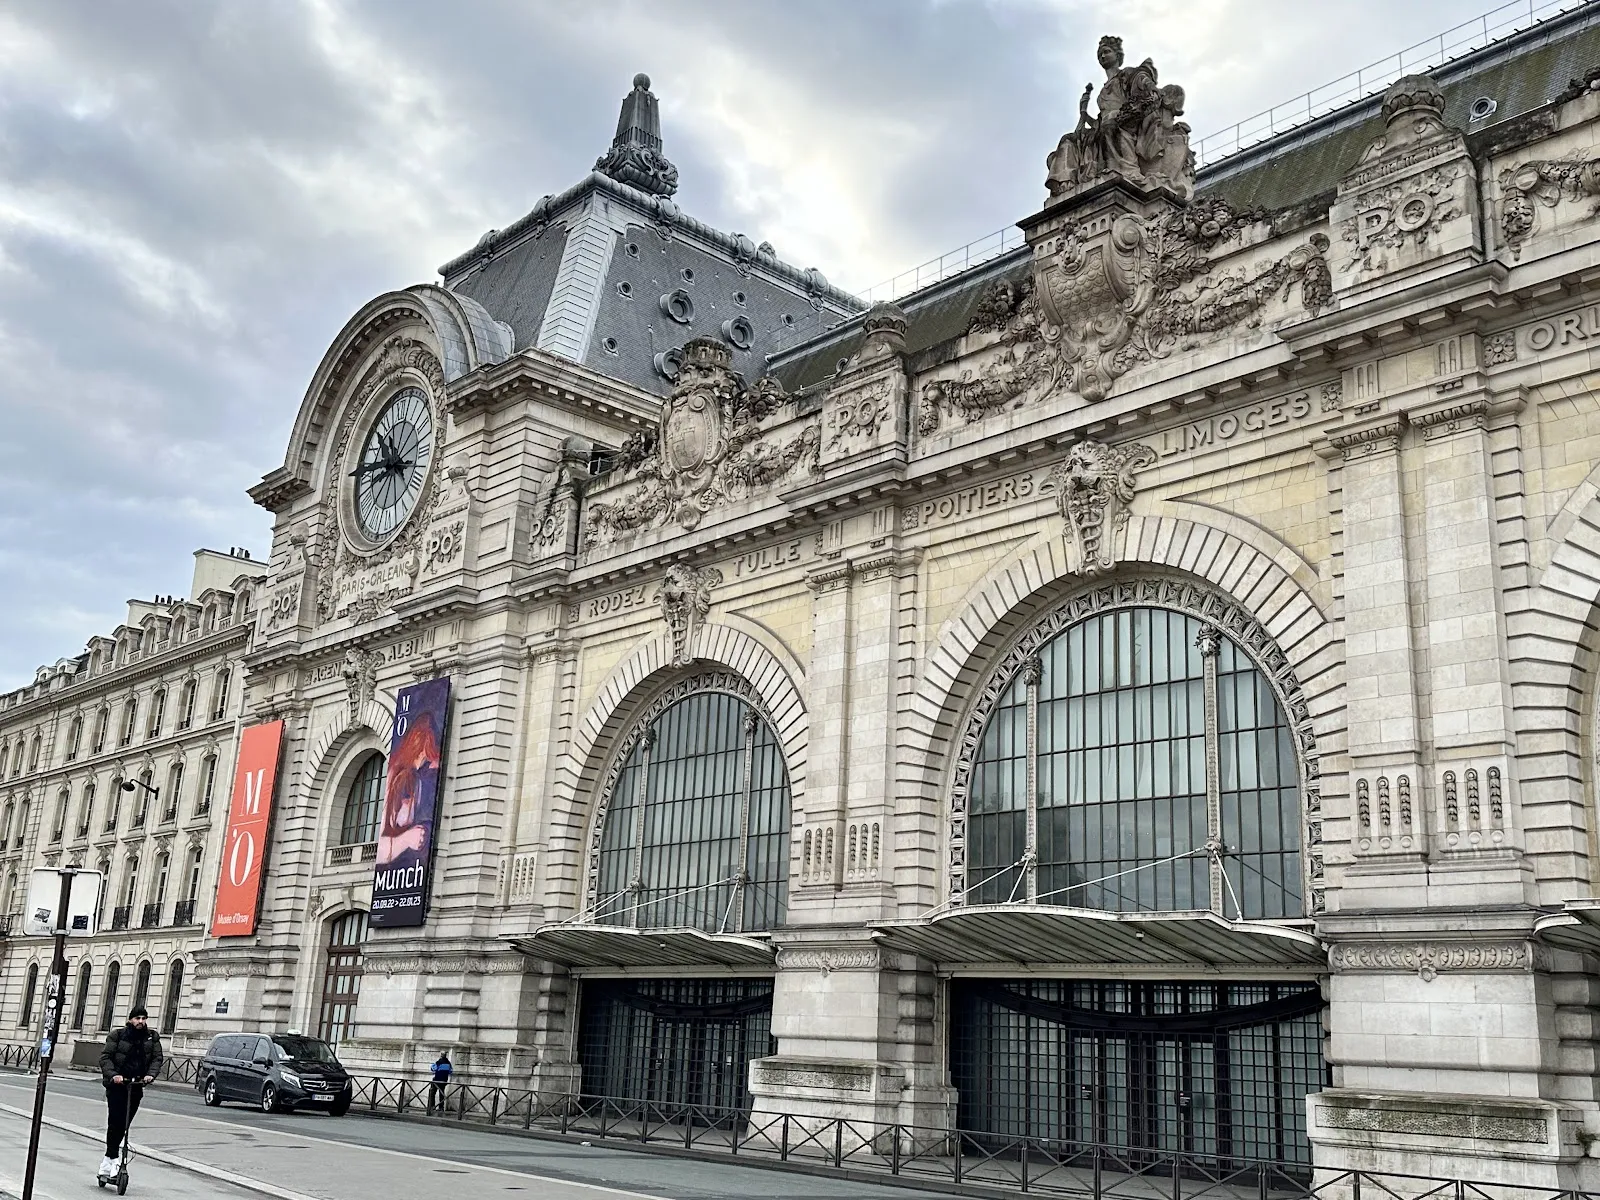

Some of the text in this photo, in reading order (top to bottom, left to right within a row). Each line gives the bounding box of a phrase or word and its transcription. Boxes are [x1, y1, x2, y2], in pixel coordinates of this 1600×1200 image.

[1159, 391, 1311, 458] LIMOGES
[921, 473, 1034, 525] POITIERS
[733, 540, 801, 577] TULLE
[588, 585, 647, 618] RODEZ
[387, 638, 420, 662] ALBI
[239, 768, 266, 817] M
[374, 858, 424, 892] Munch
[372, 898, 395, 910] 20.09.22
[399, 896, 421, 908] 22.01.23
